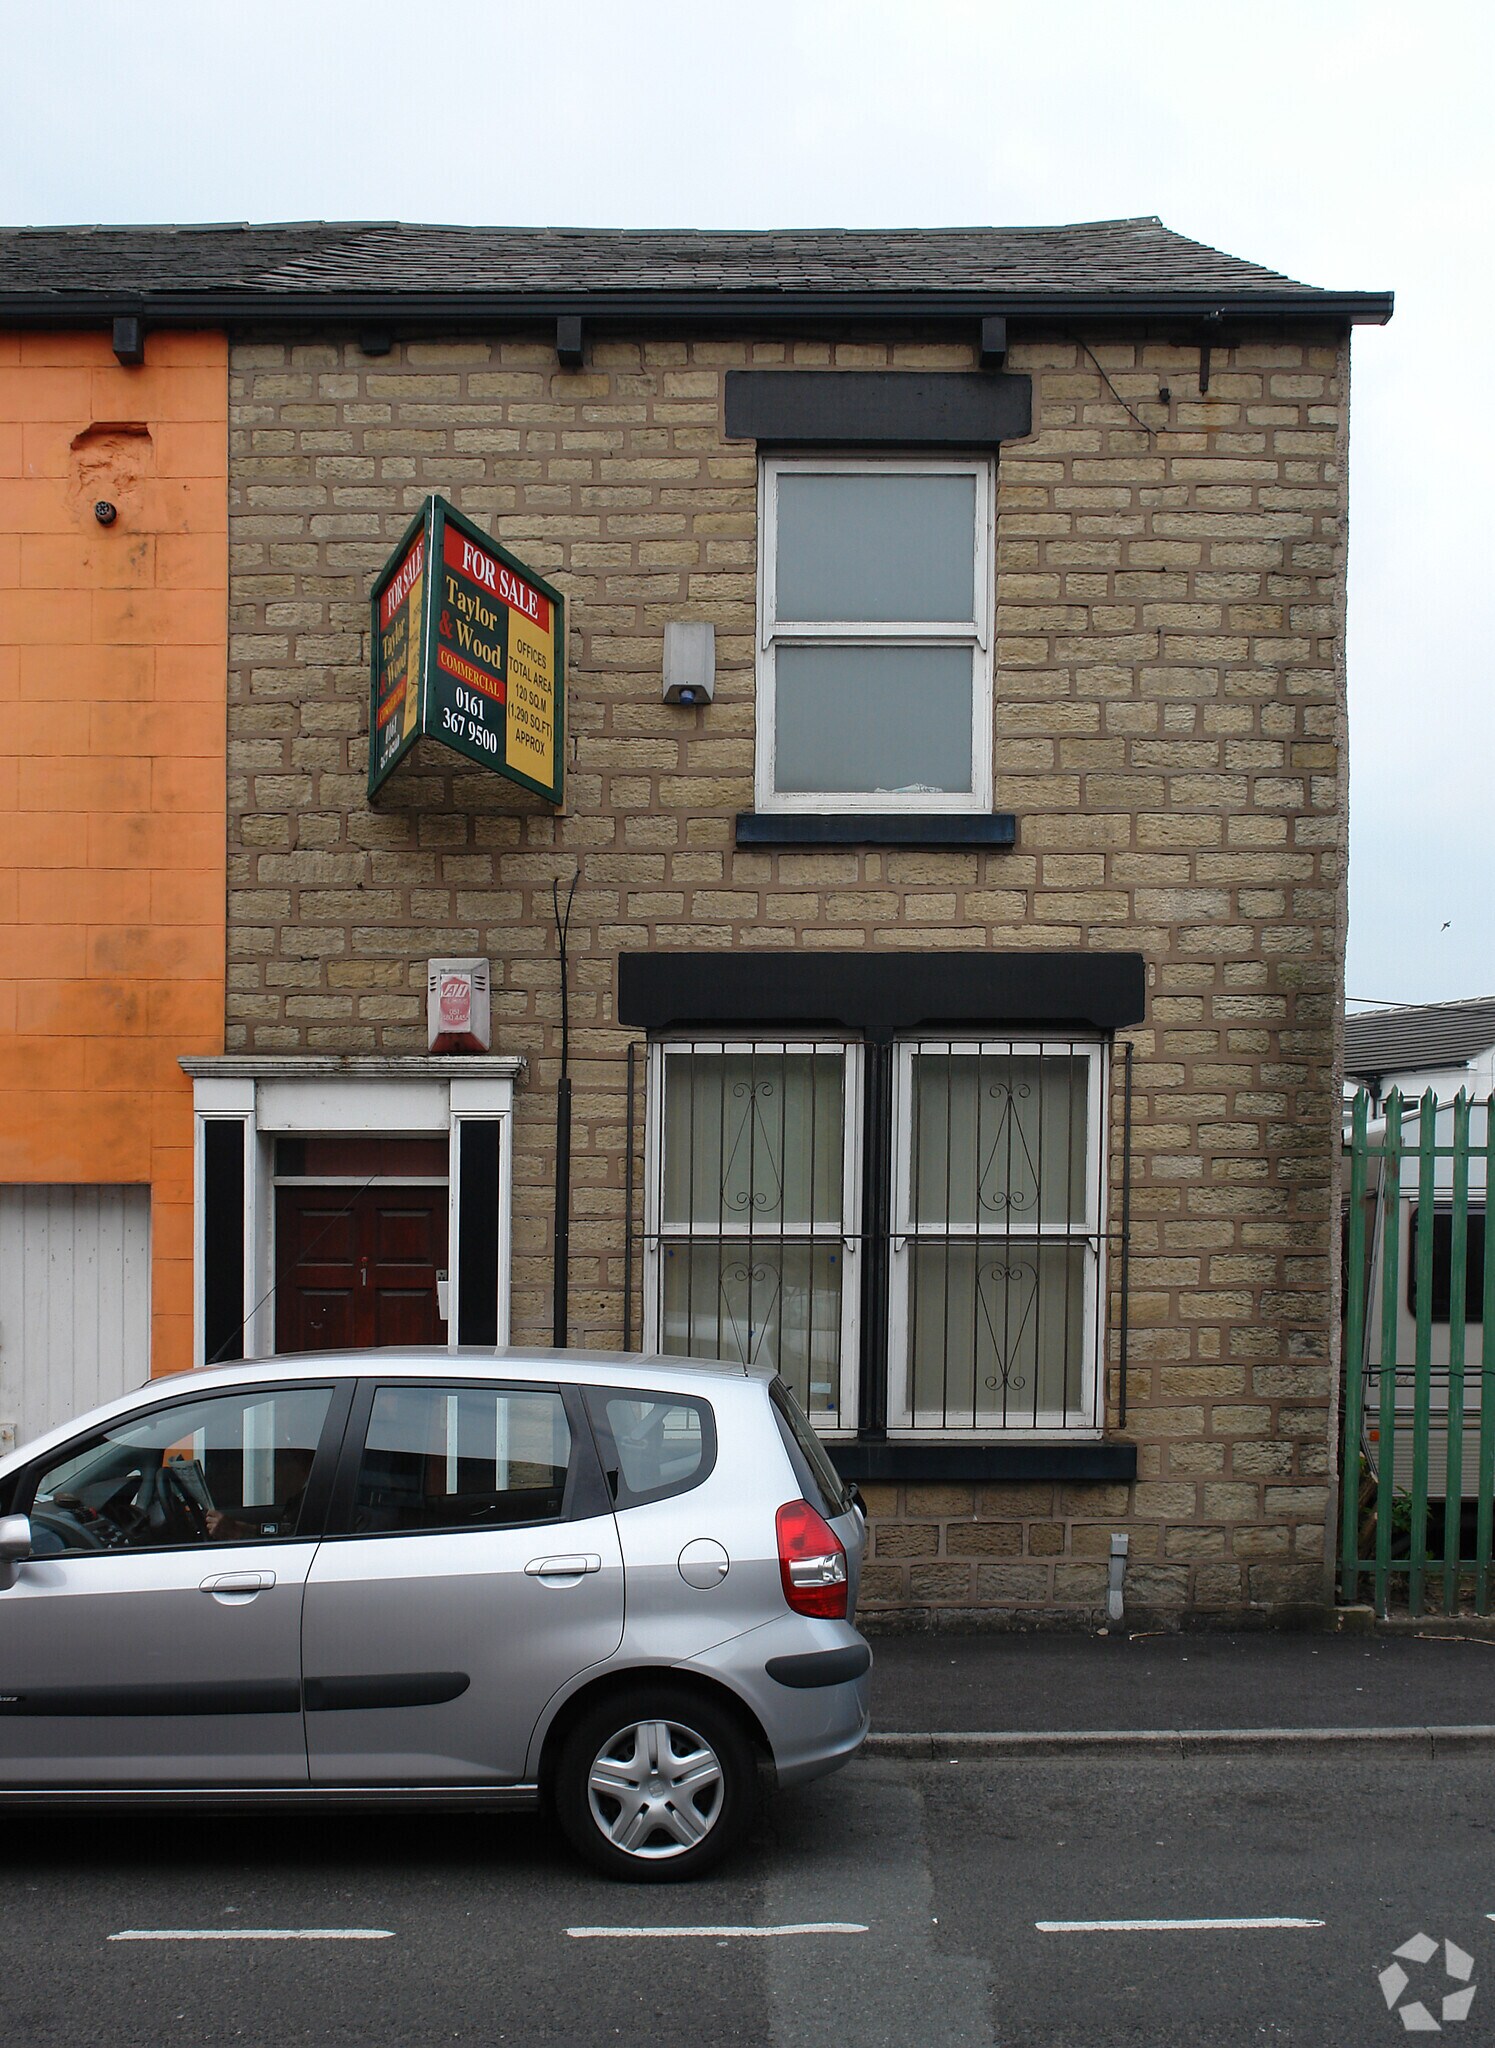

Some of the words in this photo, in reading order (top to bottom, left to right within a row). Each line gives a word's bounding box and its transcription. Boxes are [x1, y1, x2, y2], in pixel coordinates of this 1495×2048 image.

[462, 540, 496, 590] FOR
[499, 569, 538, 619] SALE
[446, 575, 498, 632] Taylor
[439, 610, 452, 639] &
[456, 619, 501, 669] Wood
[516, 639, 547, 669] OFFICES
[441, 650, 500, 697] COMMERCIAL
[509, 656, 532, 683] TOTAL
[533, 672, 553, 696] AREA
[516, 683, 528, 702] 120
[456, 687, 485, 721] 0161
[508, 701, 529, 725] (1,290
[443, 707, 466, 736] 367
[468, 721, 498, 754] 9500
[515, 728, 545, 757] APPROX
